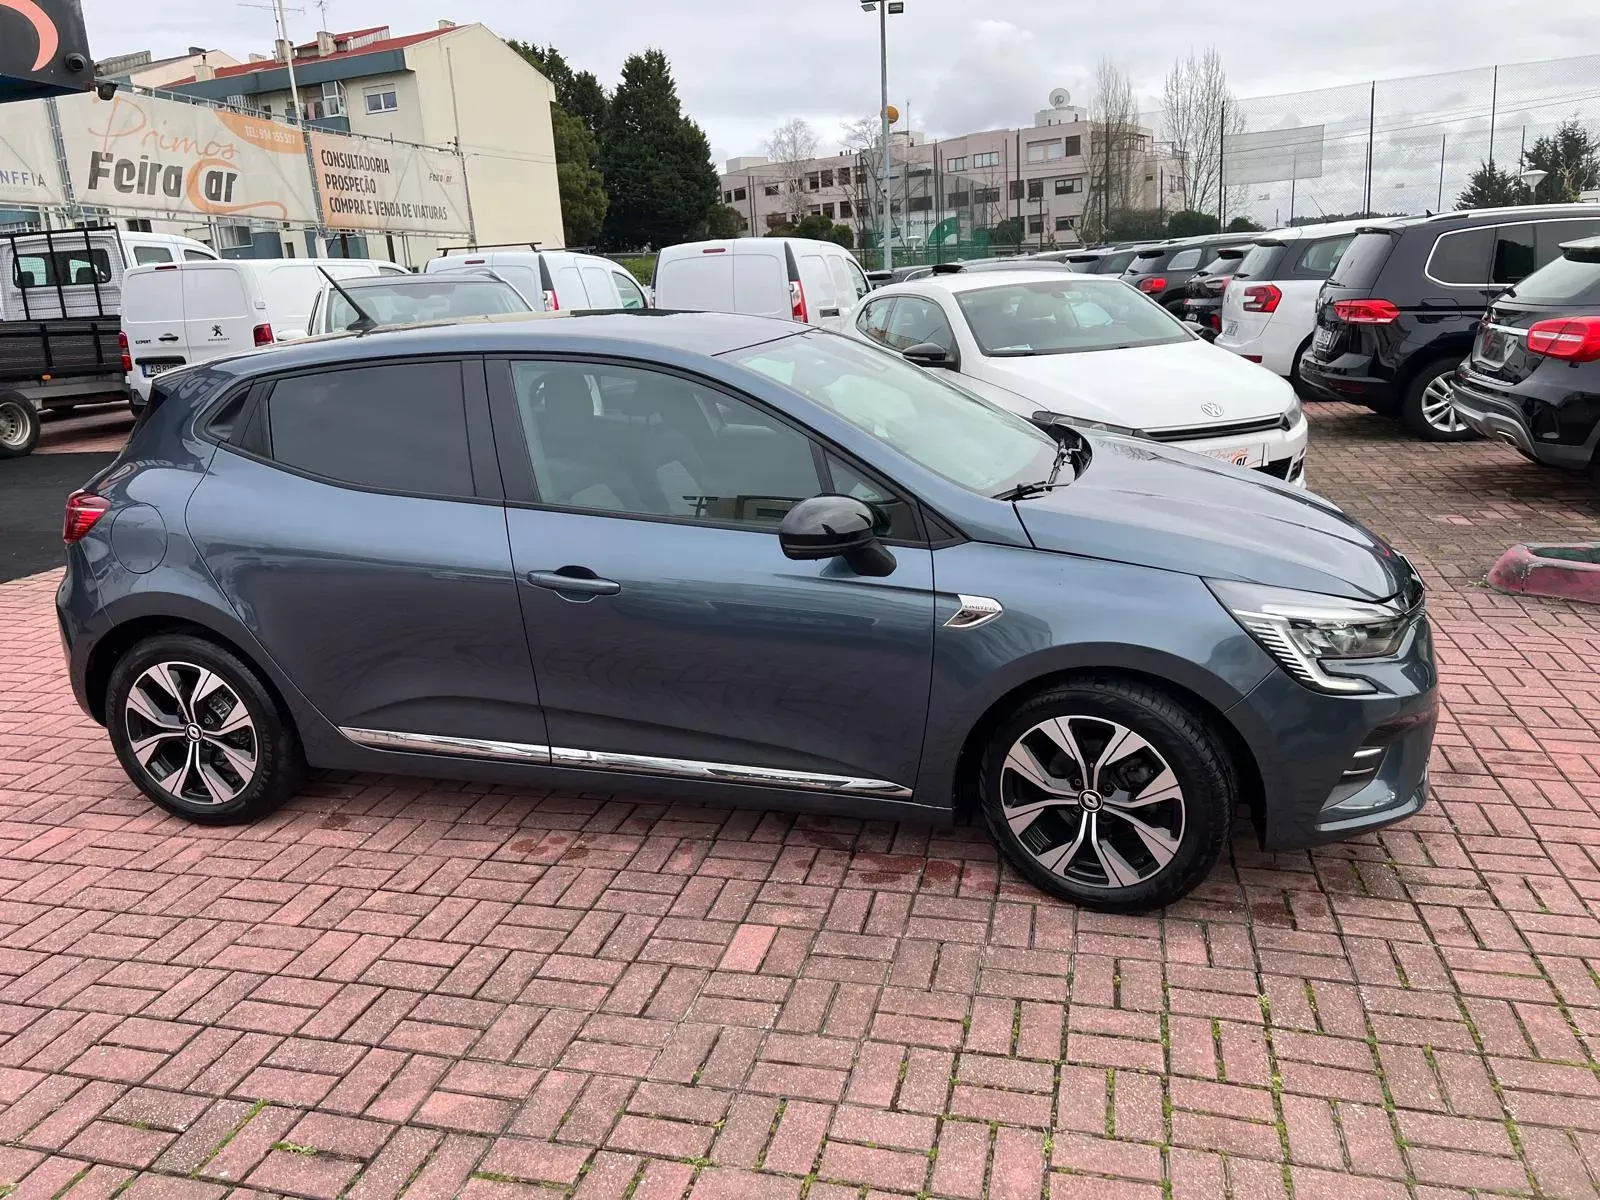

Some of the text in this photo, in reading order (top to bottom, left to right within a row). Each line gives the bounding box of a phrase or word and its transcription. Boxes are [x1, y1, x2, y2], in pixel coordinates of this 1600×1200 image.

[88, 96, 240, 160] Primos
[321, 150, 390, 173] CONSULTADORIA
[325, 174, 376, 196] PROSPEÇÃO
[329, 197, 448, 220] COMPRA E VENDA DE VIATURAS
